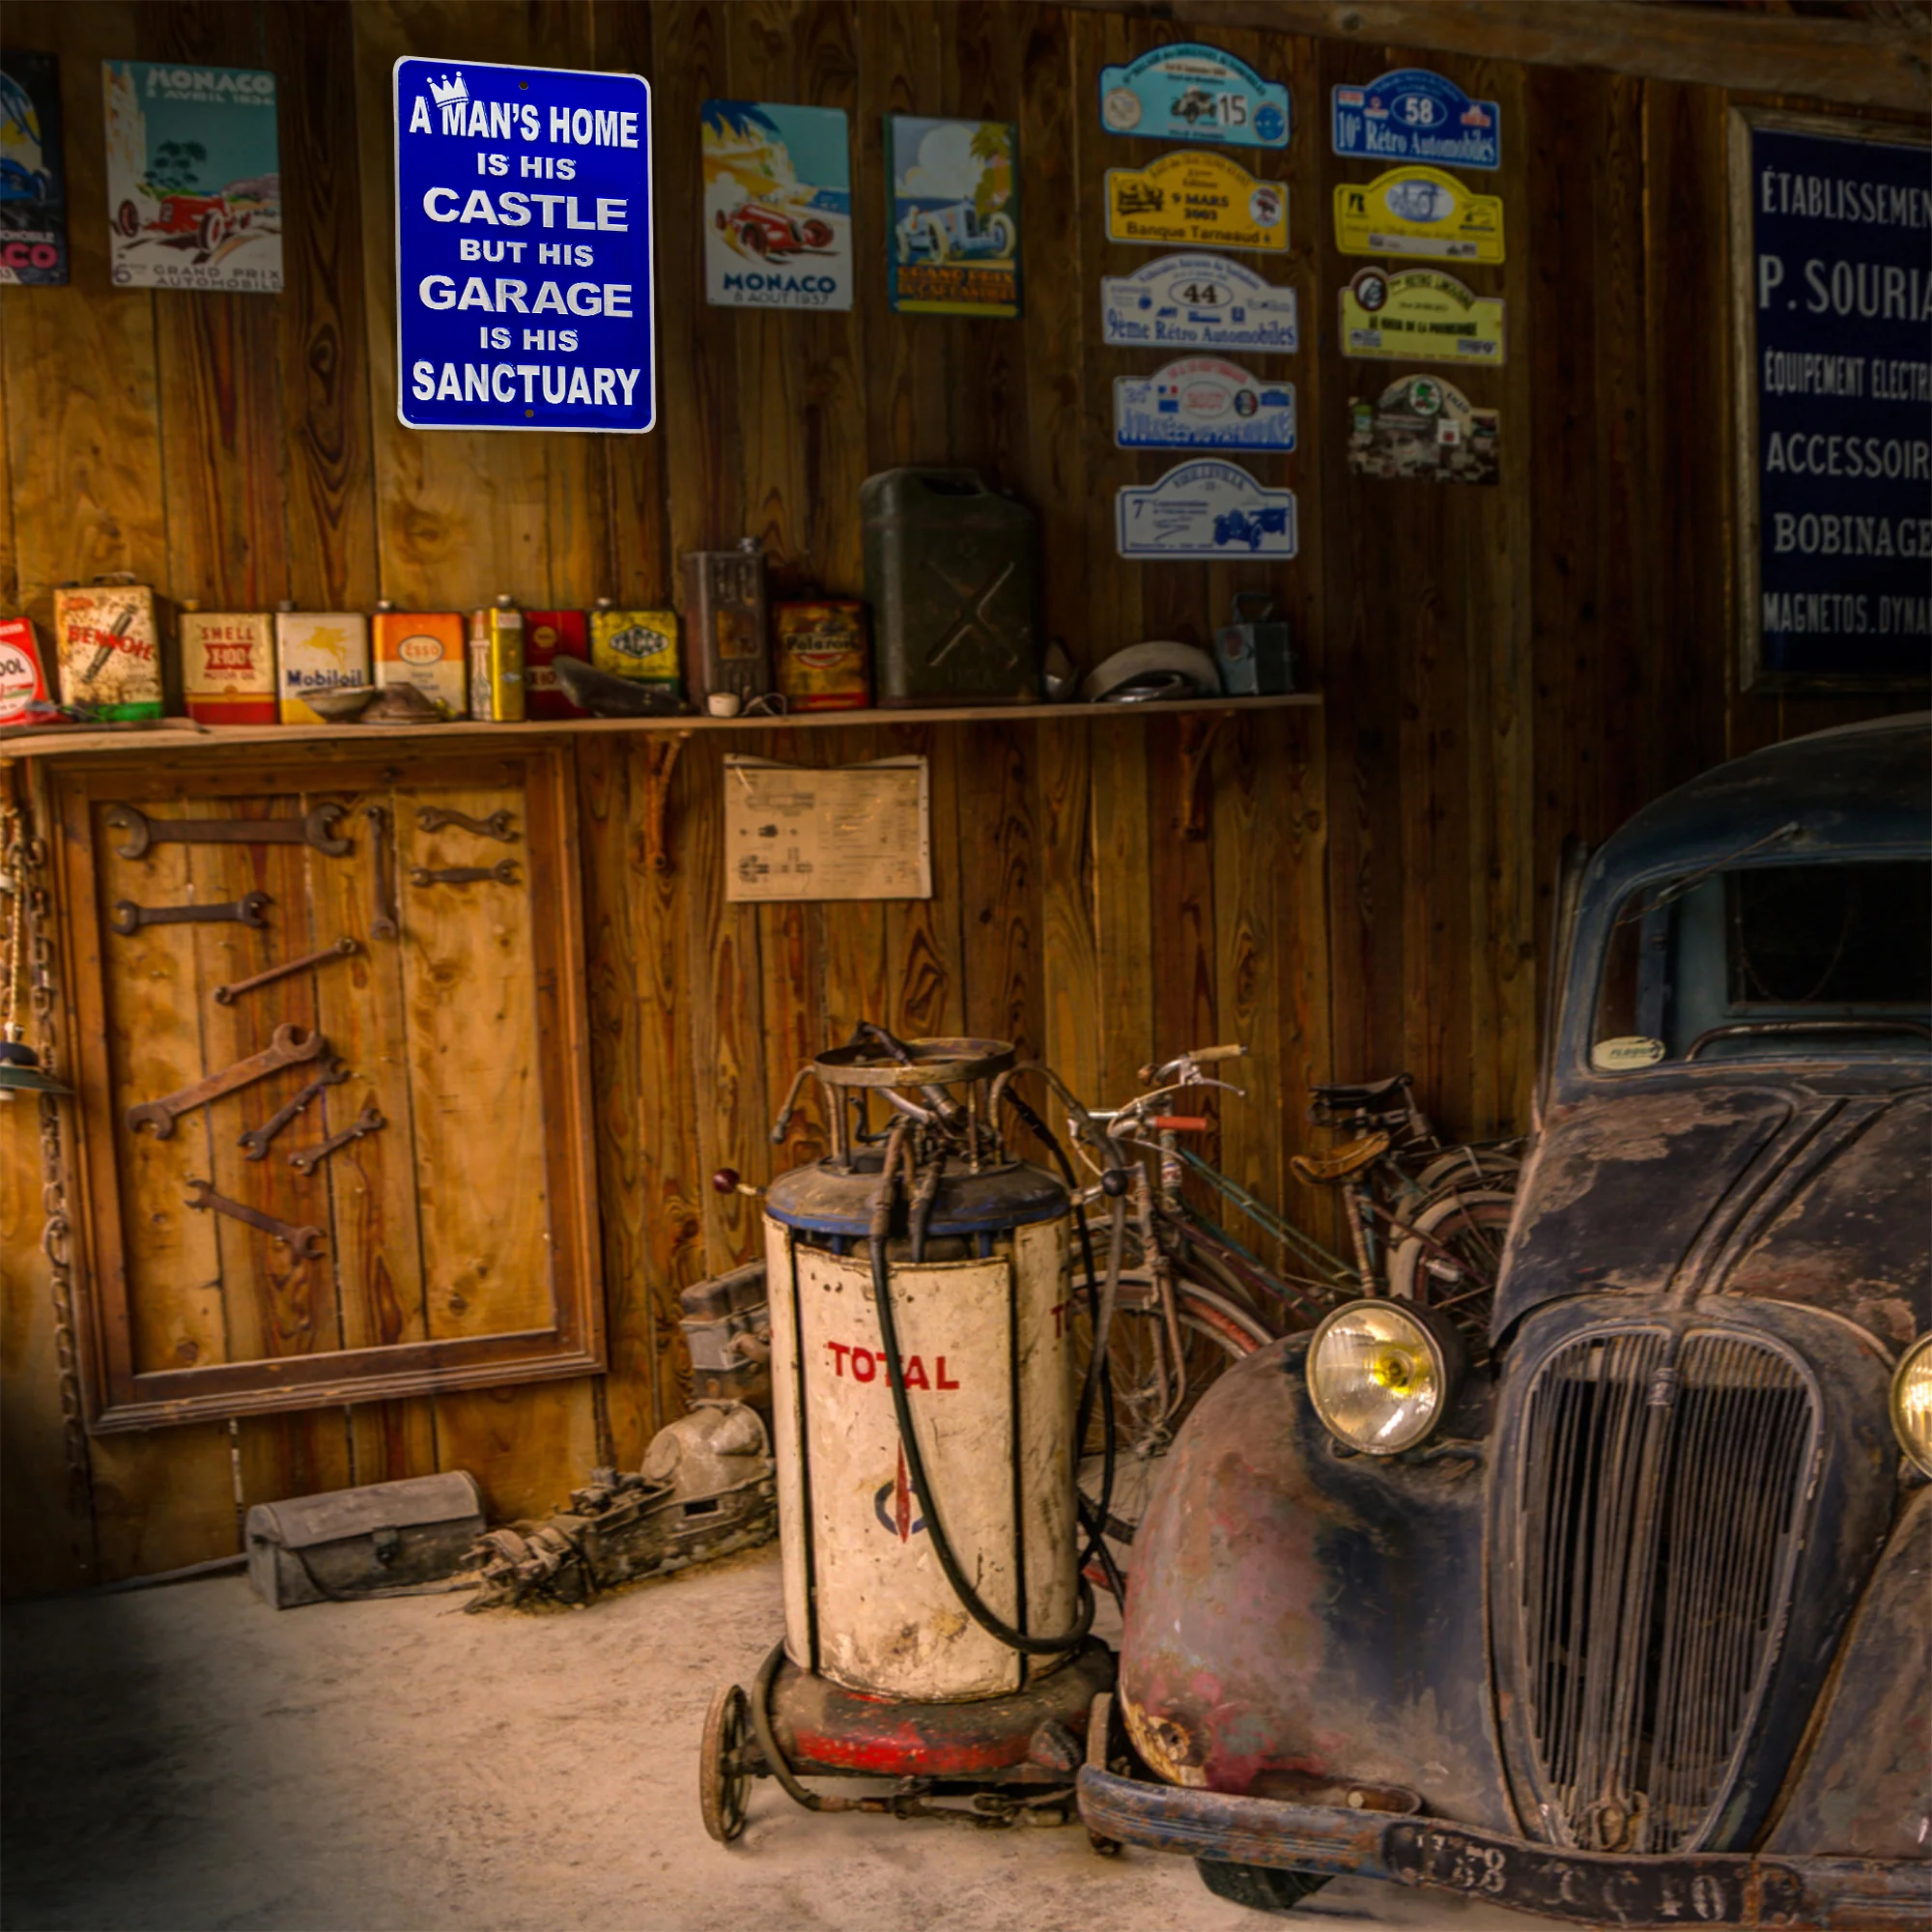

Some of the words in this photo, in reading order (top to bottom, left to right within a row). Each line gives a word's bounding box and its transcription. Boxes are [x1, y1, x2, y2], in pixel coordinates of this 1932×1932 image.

[147, 68, 274, 95] MONACO
[409, 95, 432, 133] A
[441, 100, 541, 142] MAN'S
[549, 105, 639, 148] HOME
[1218, 95, 1247, 125] 15
[1405, 98, 1435, 125] 58
[477, 153, 509, 176] IS
[520, 156, 577, 181] HIS
[422, 186, 629, 232] CASTLE
[1126, 220, 1186, 241] Banque
[460, 239, 527, 263] BUT
[538, 243, 595, 268] HIS
[154, 265, 221, 277] GRAND
[233, 268, 280, 279] PRIX
[723, 271, 838, 293] MONACO
[418, 275, 634, 318] GARAGE
[1182, 284, 1219, 304] 44
[479, 327, 511, 350] IS
[523, 329, 579, 353] HIS
[412, 360, 640, 406] SANCTUARY
[201, 626, 254, 641] SHELL
[287, 668, 363, 687] Mobiloil
